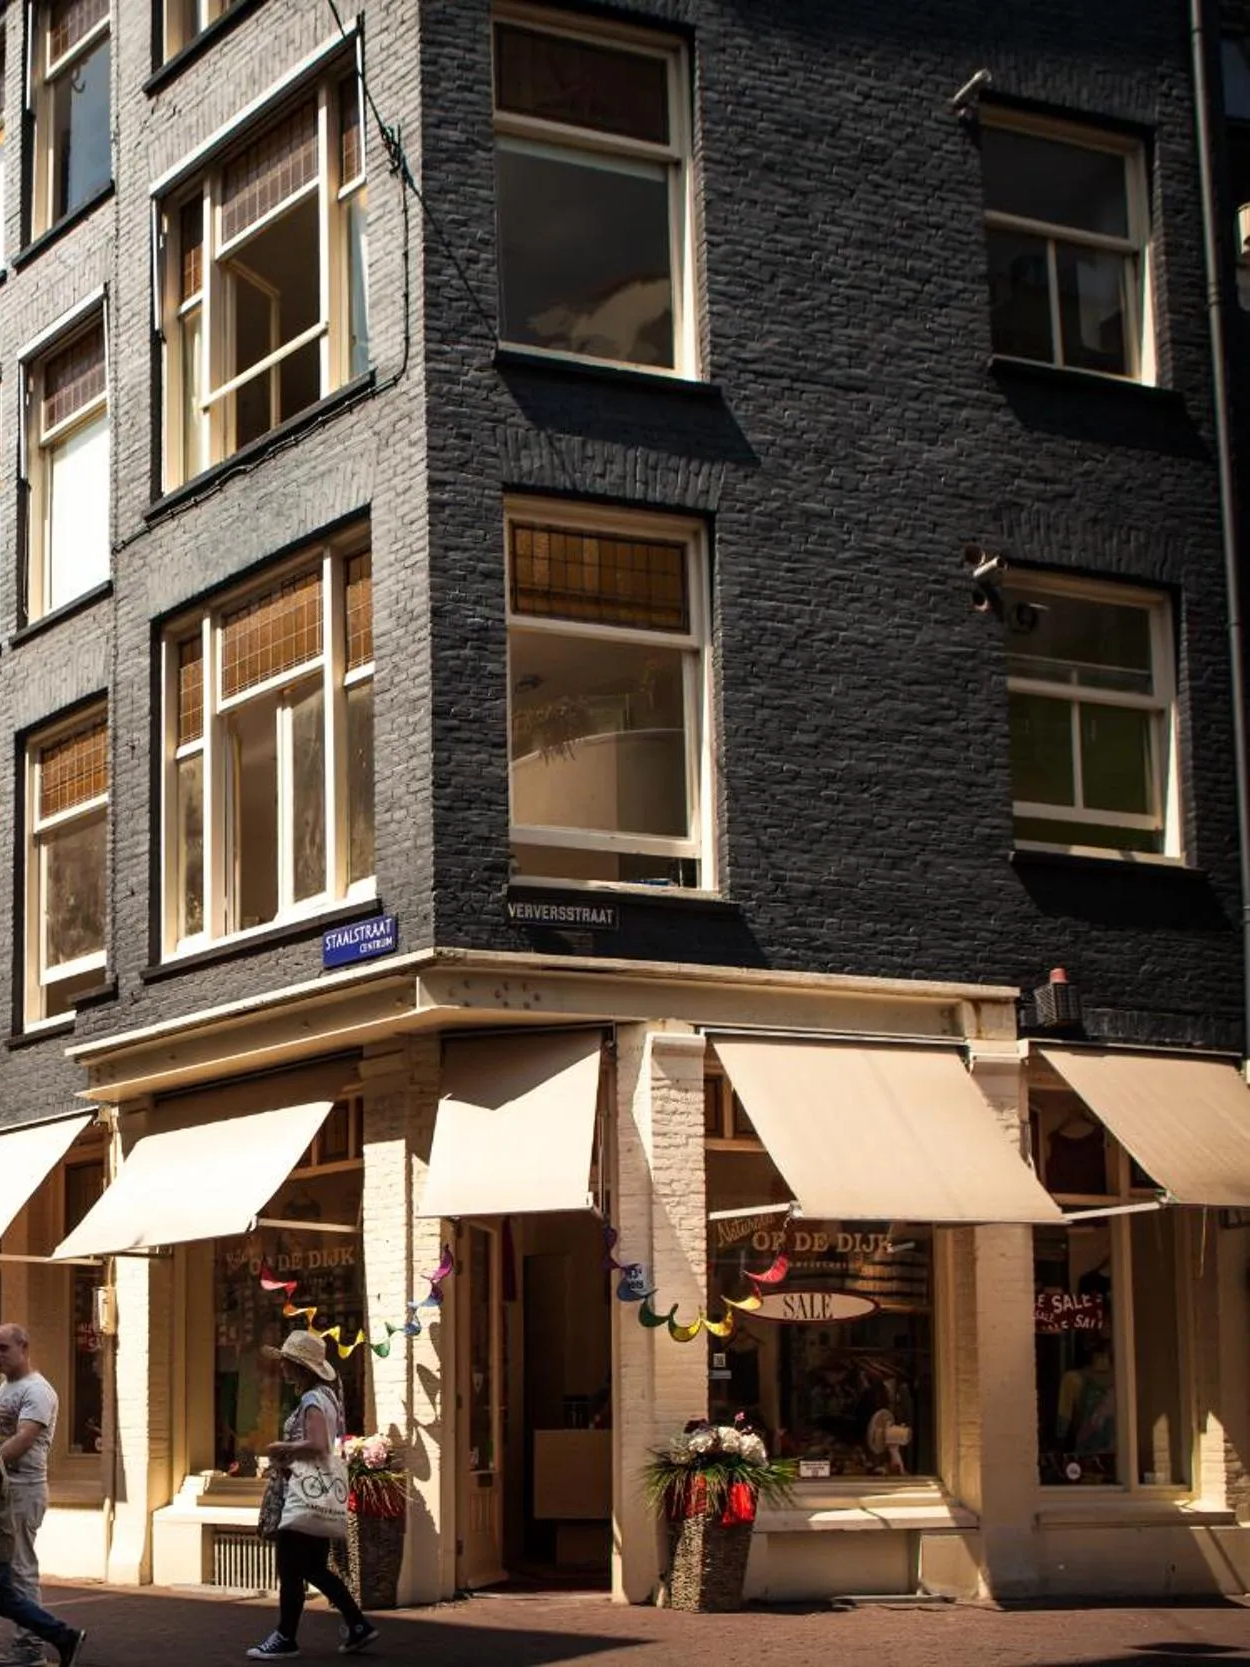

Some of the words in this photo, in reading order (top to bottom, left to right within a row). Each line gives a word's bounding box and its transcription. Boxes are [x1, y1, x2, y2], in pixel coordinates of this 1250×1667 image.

[507, 901, 615, 925] VERVERSSTRAAT
[325, 918, 392, 950] STAALSTRAAT
[359, 936, 393, 953] CENTRUM
[792, 1232, 829, 1252] DE
[308, 1247, 356, 1269] DIJK
[782, 1292, 833, 1320] SALE
[1050, 1293, 1093, 1314] SALE
